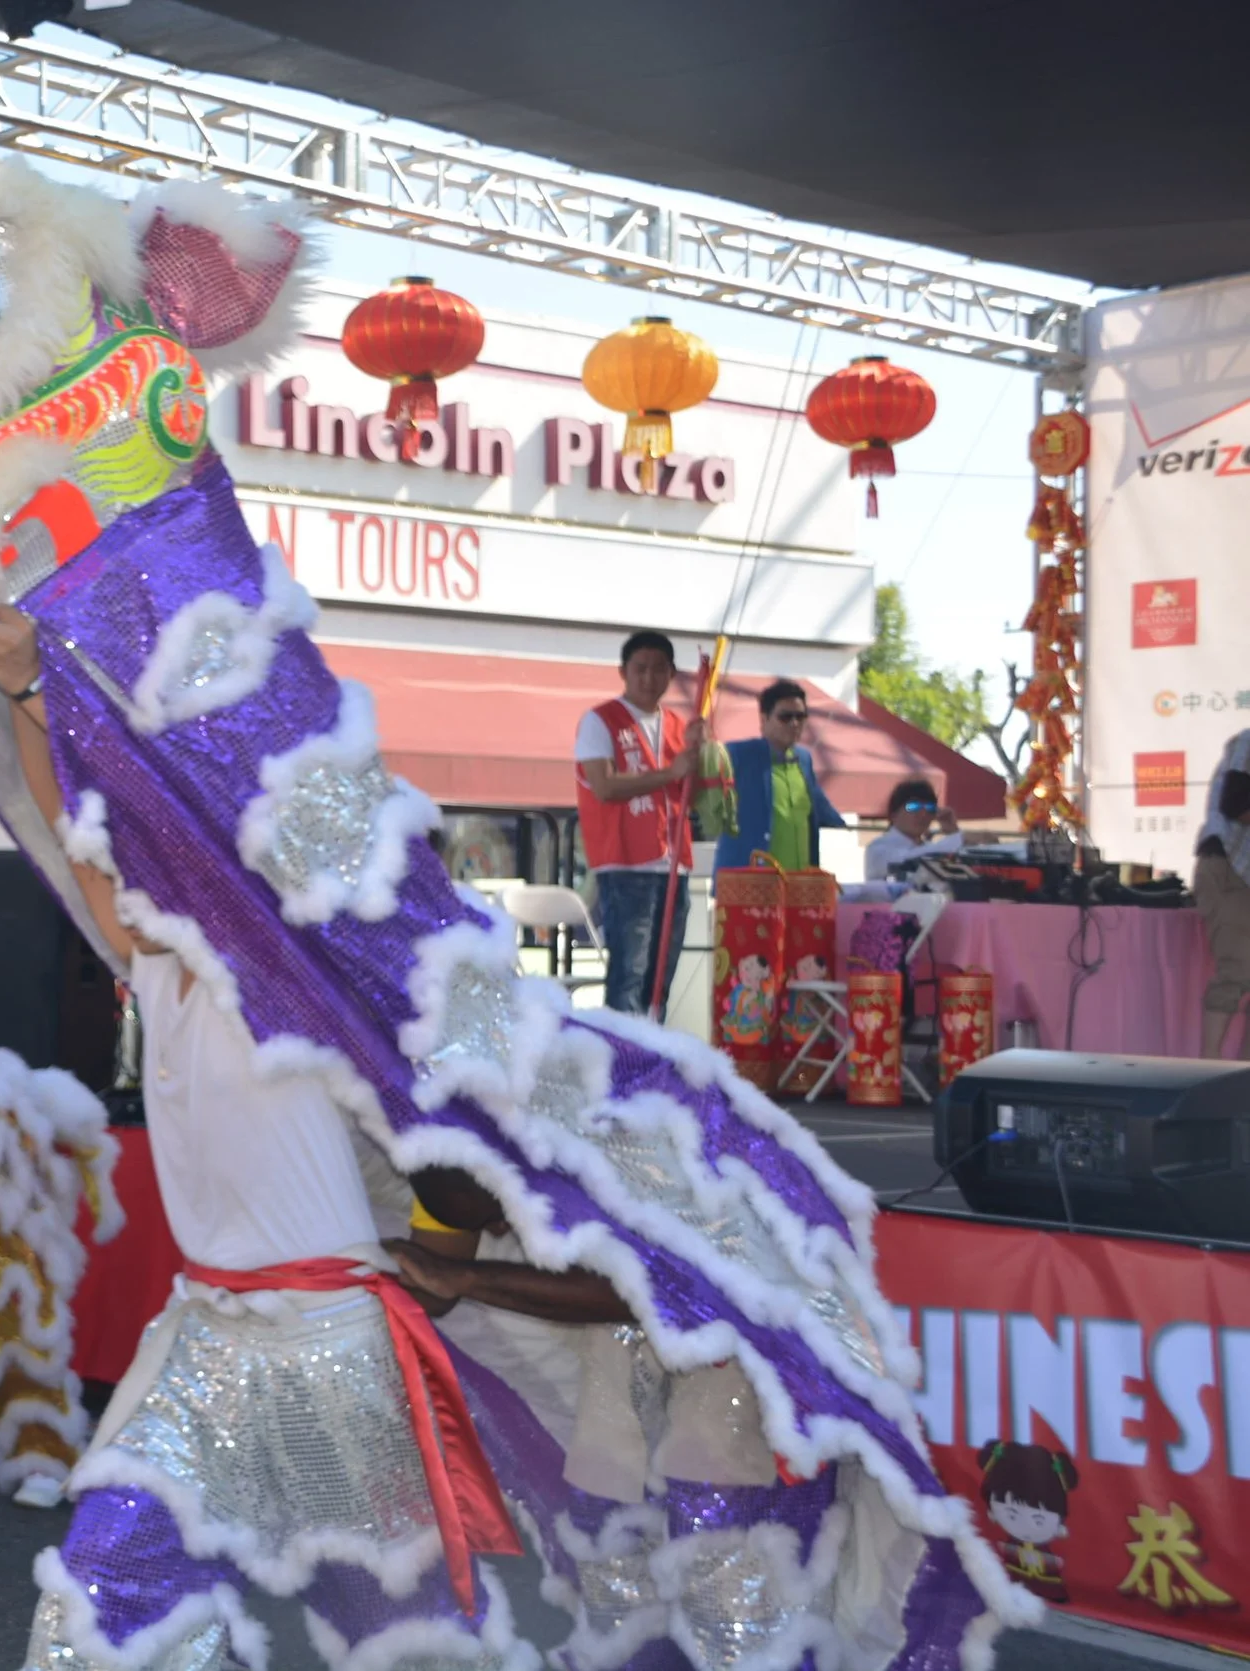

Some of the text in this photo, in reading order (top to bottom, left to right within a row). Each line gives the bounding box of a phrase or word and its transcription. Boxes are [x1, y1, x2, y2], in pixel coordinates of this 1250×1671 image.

[238, 372, 736, 504] Lincoln Plaza
[328, 511, 481, 602] TOURS
[892, 1304, 1250, 1480] HINES
[1116, 1501, 1236, 1610] 恭
